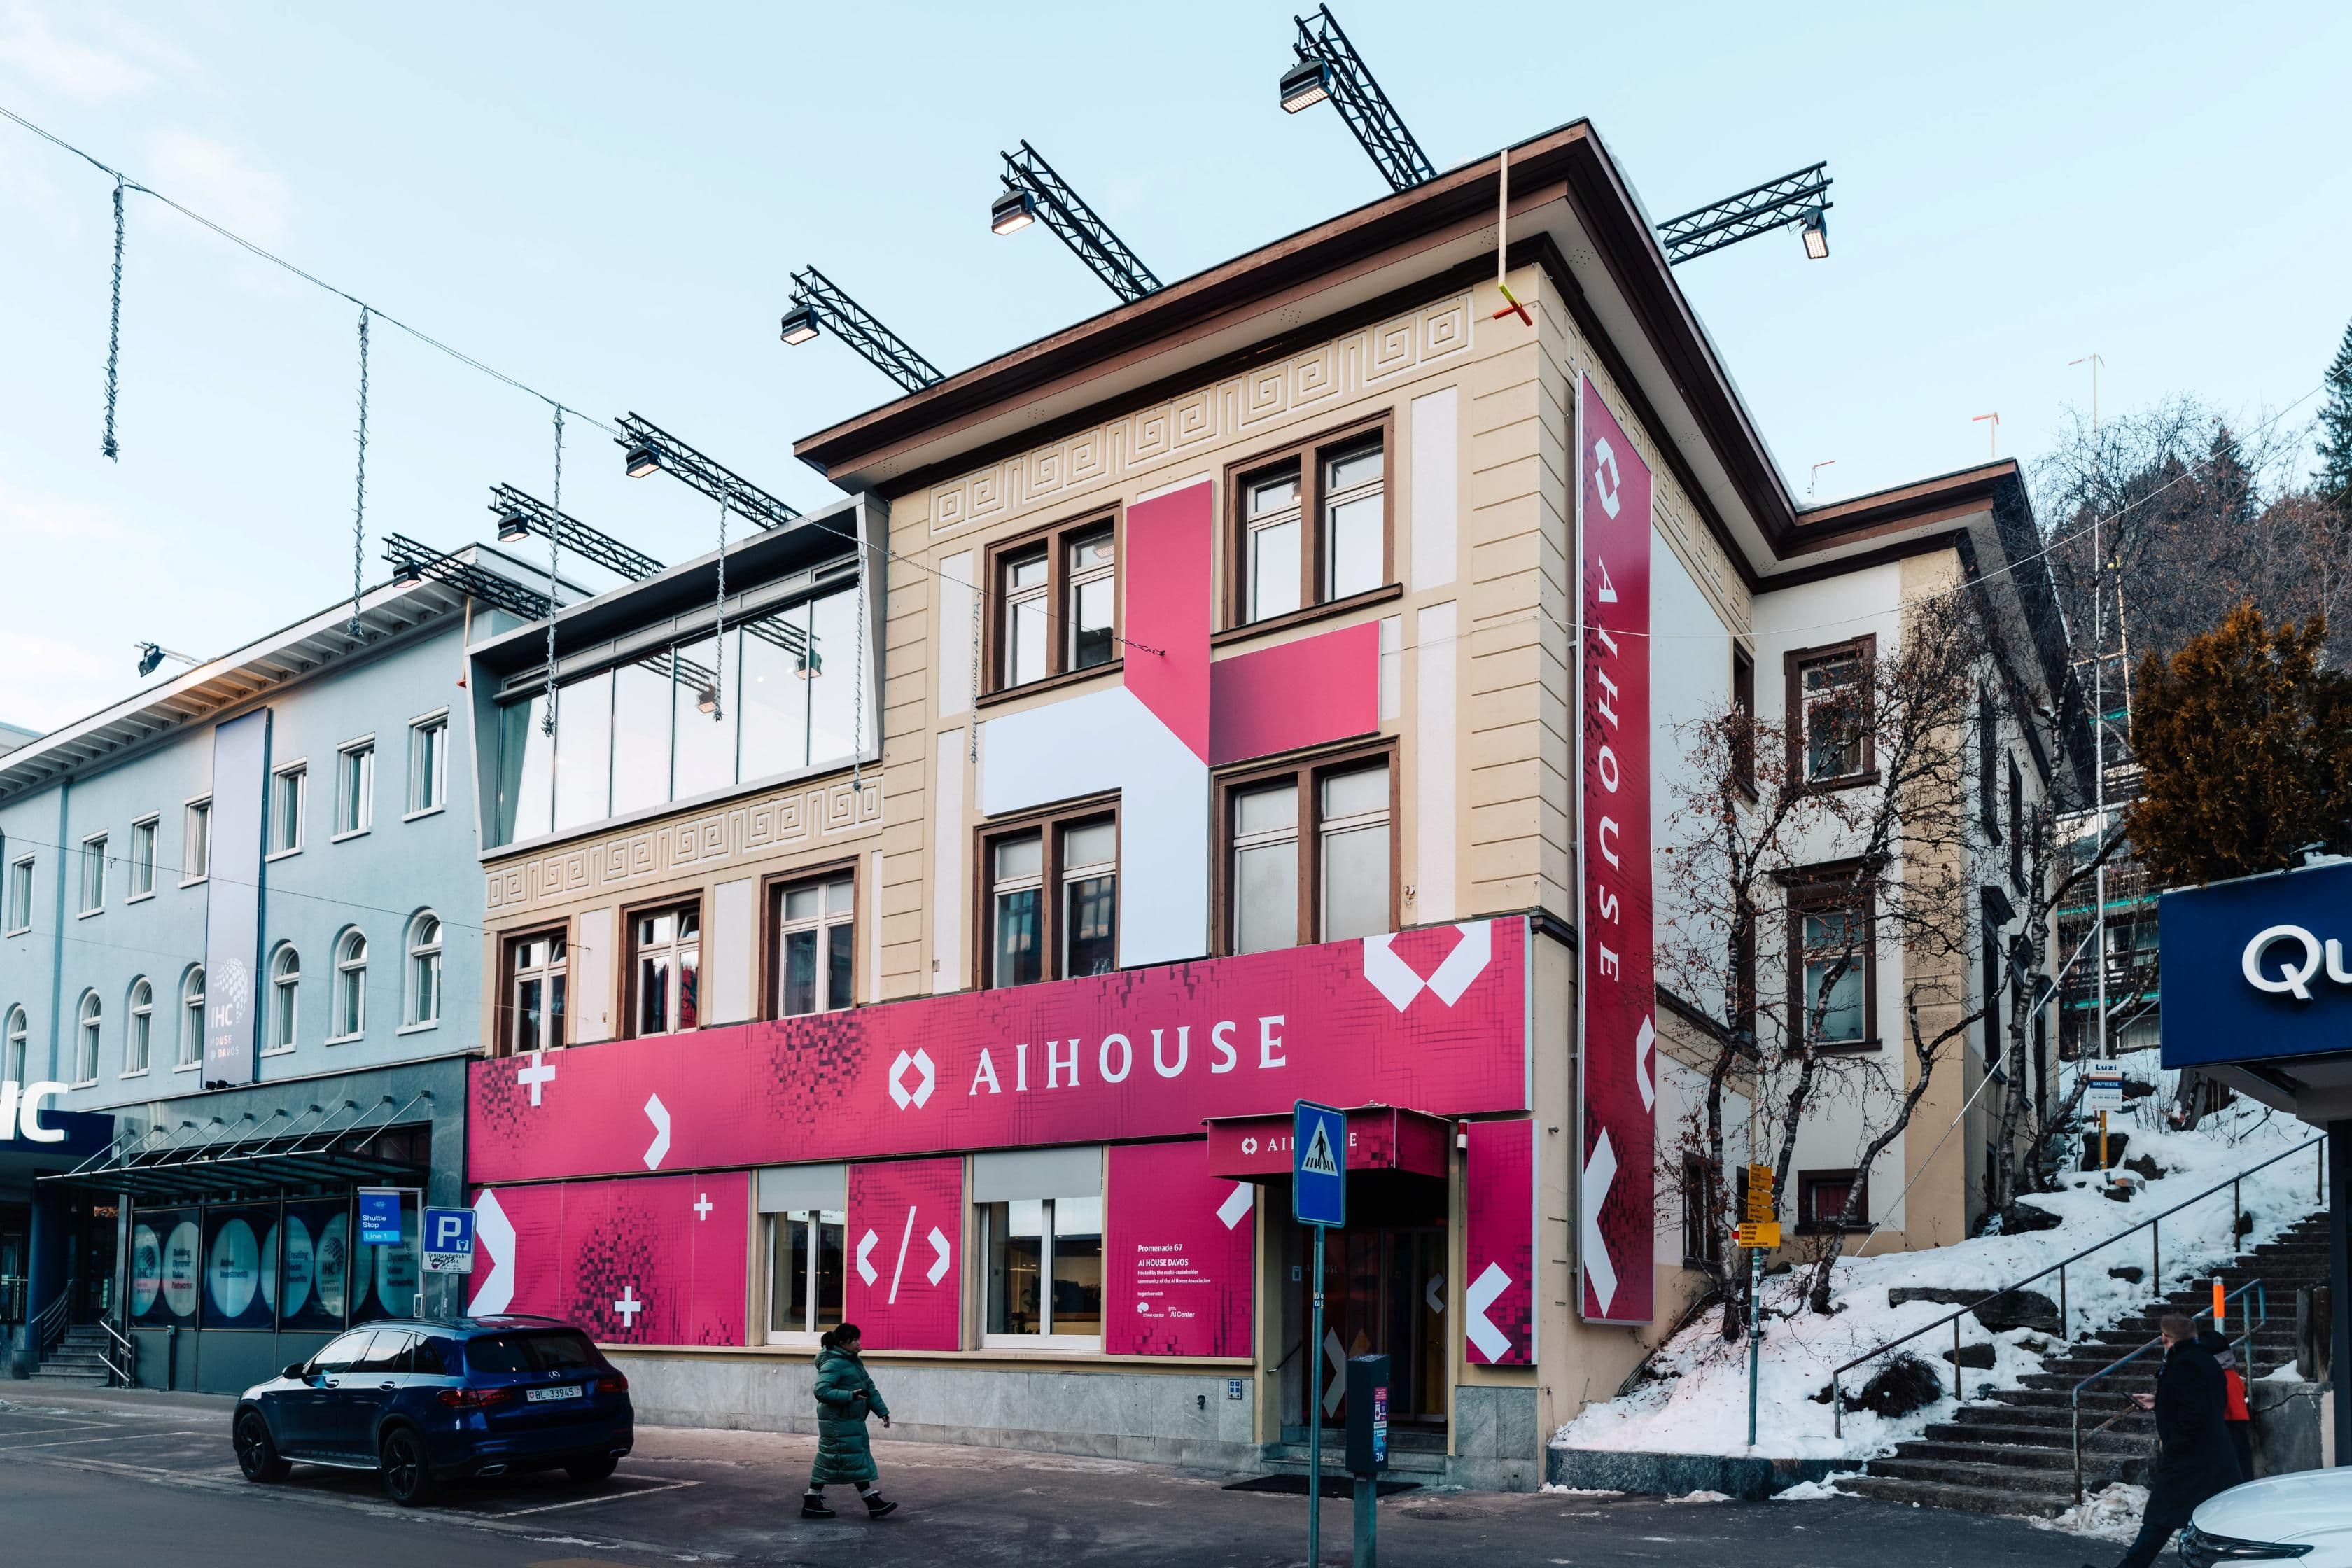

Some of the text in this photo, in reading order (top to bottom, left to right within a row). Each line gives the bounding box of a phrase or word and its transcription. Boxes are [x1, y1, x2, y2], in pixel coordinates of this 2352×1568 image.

[1598, 554, 1619, 983] AIHOUSE
[211, 1003, 233, 1028] IHC
[218, 1045, 239, 1058] DAVOS
[969, 1014, 1287, 1096] AIHOUSE
[437, 1216, 461, 1247] P
[1376, 1451, 1384, 1462] 36
